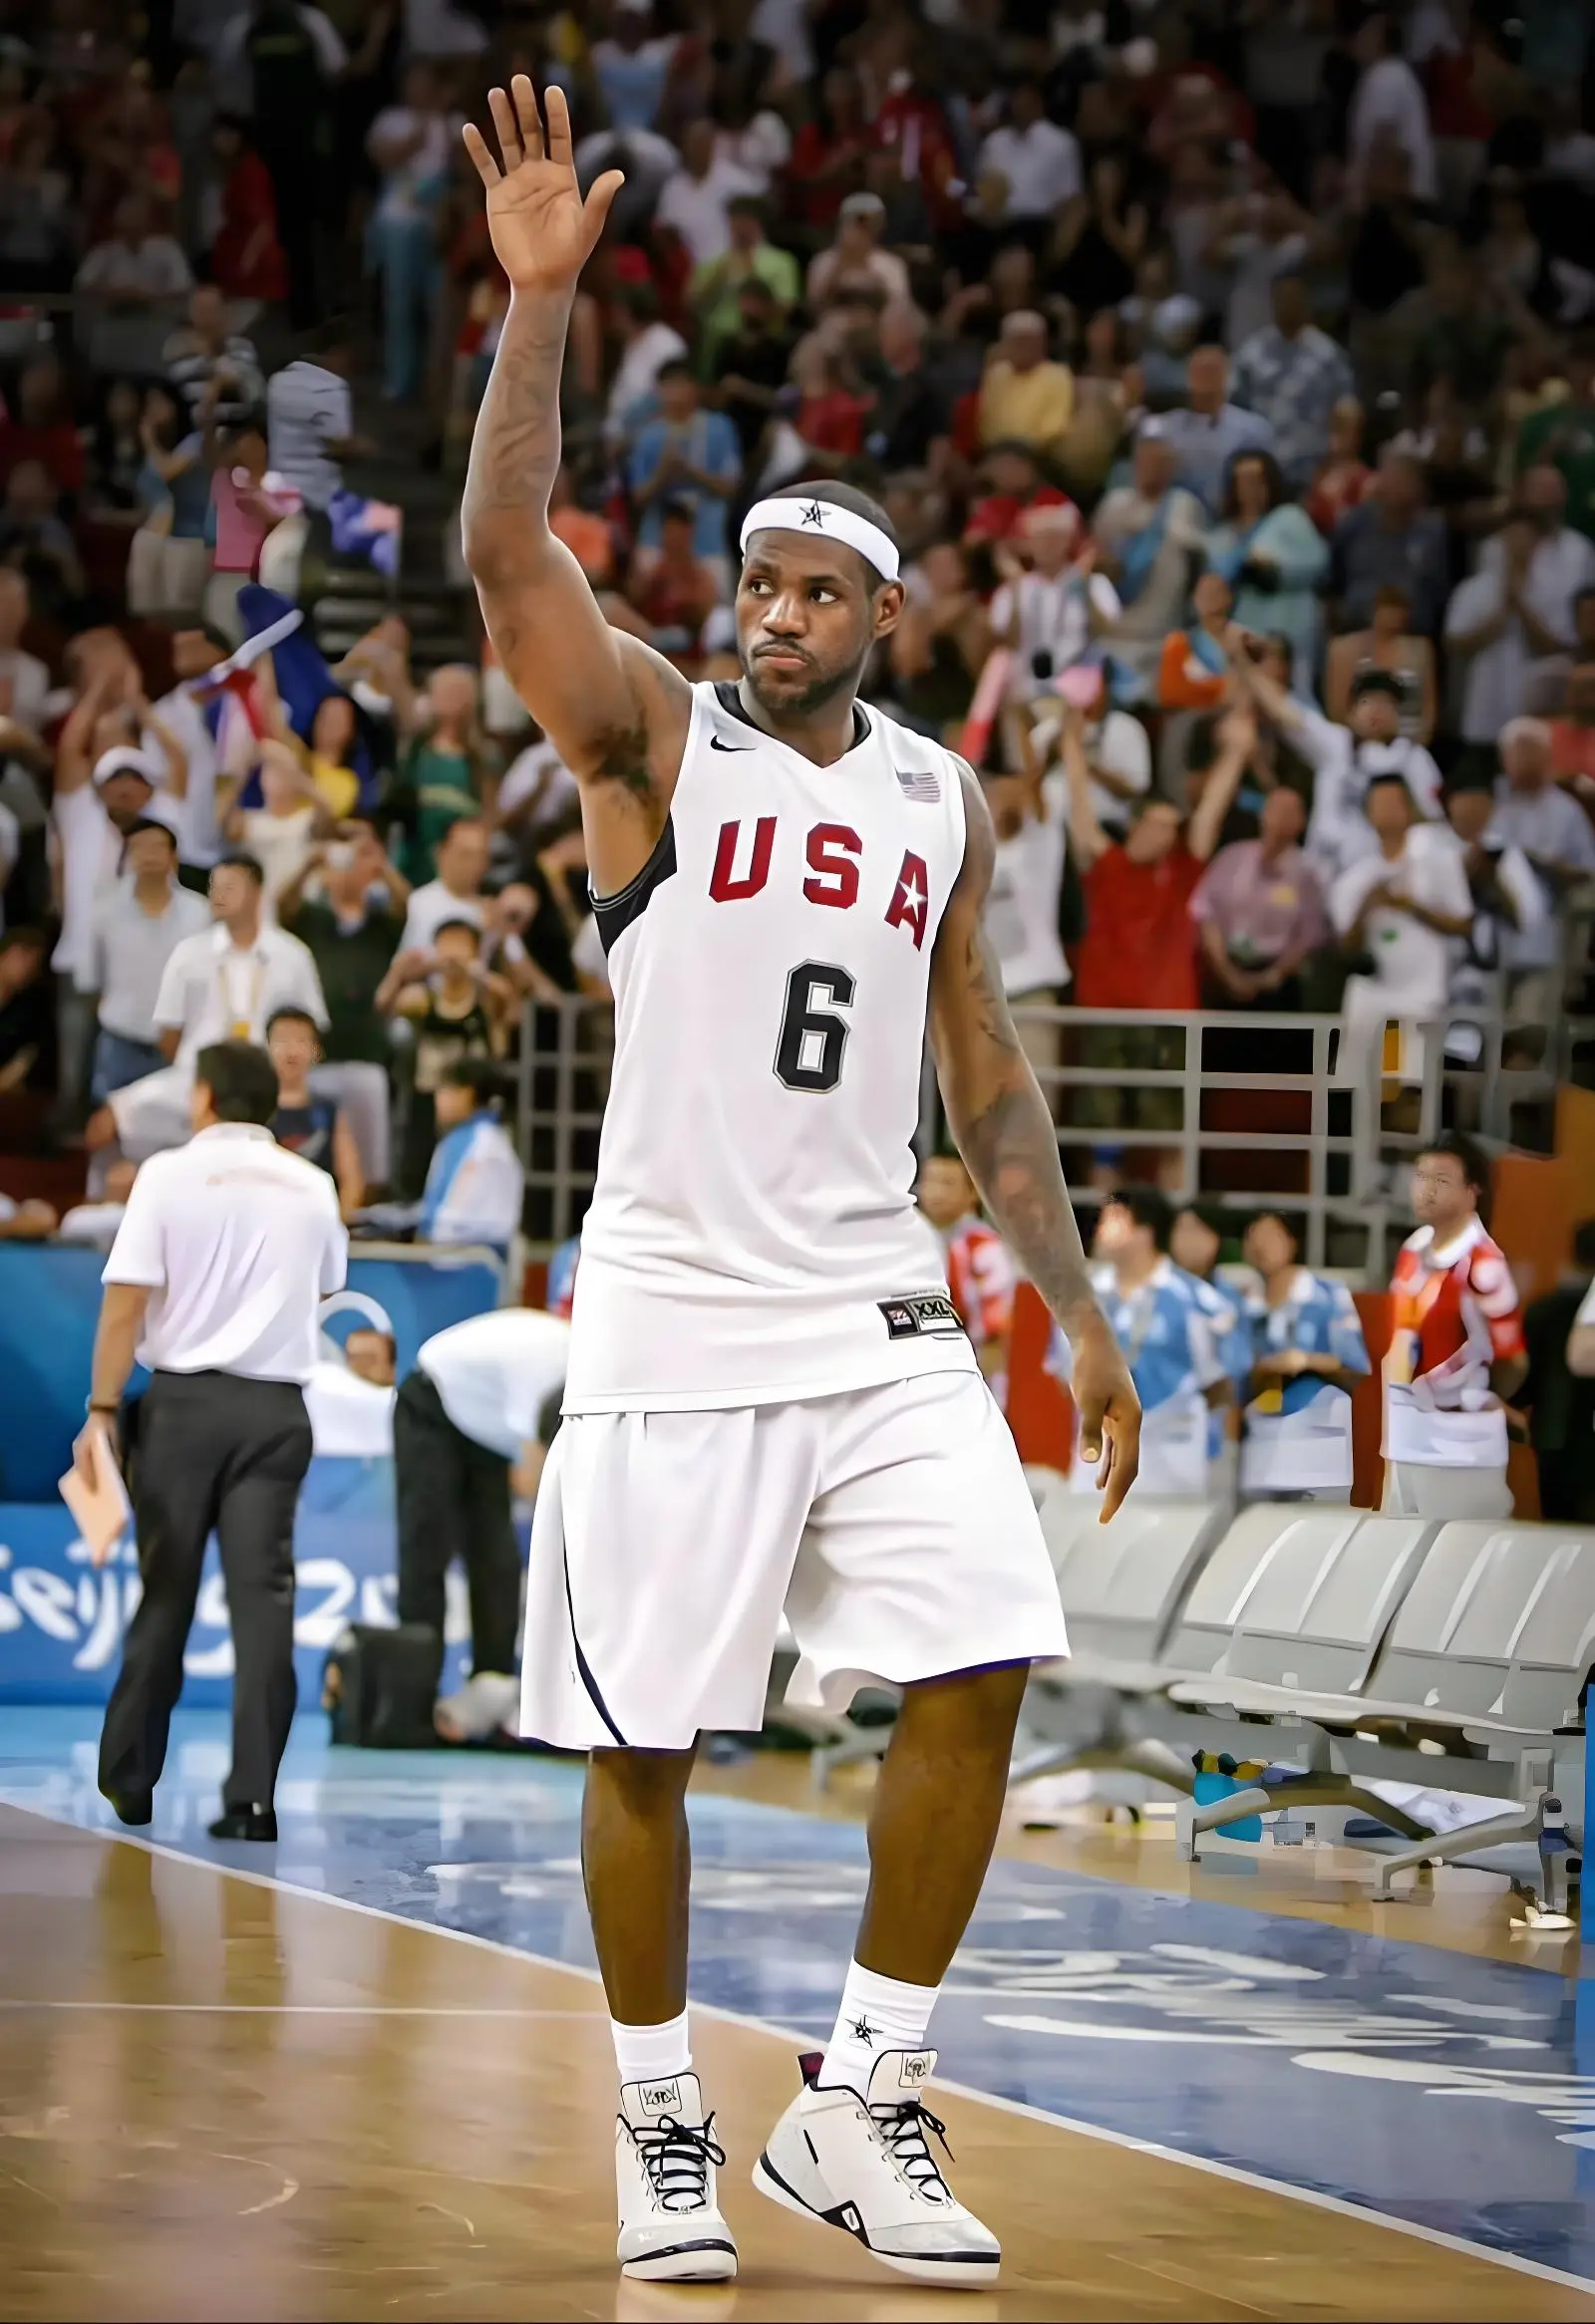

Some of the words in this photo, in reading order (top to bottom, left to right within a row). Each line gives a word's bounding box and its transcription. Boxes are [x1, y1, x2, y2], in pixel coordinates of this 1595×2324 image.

[708, 816, 929, 952] USA
[773, 958, 857, 1094] 6
[913, 1300, 950, 1316] XXL
